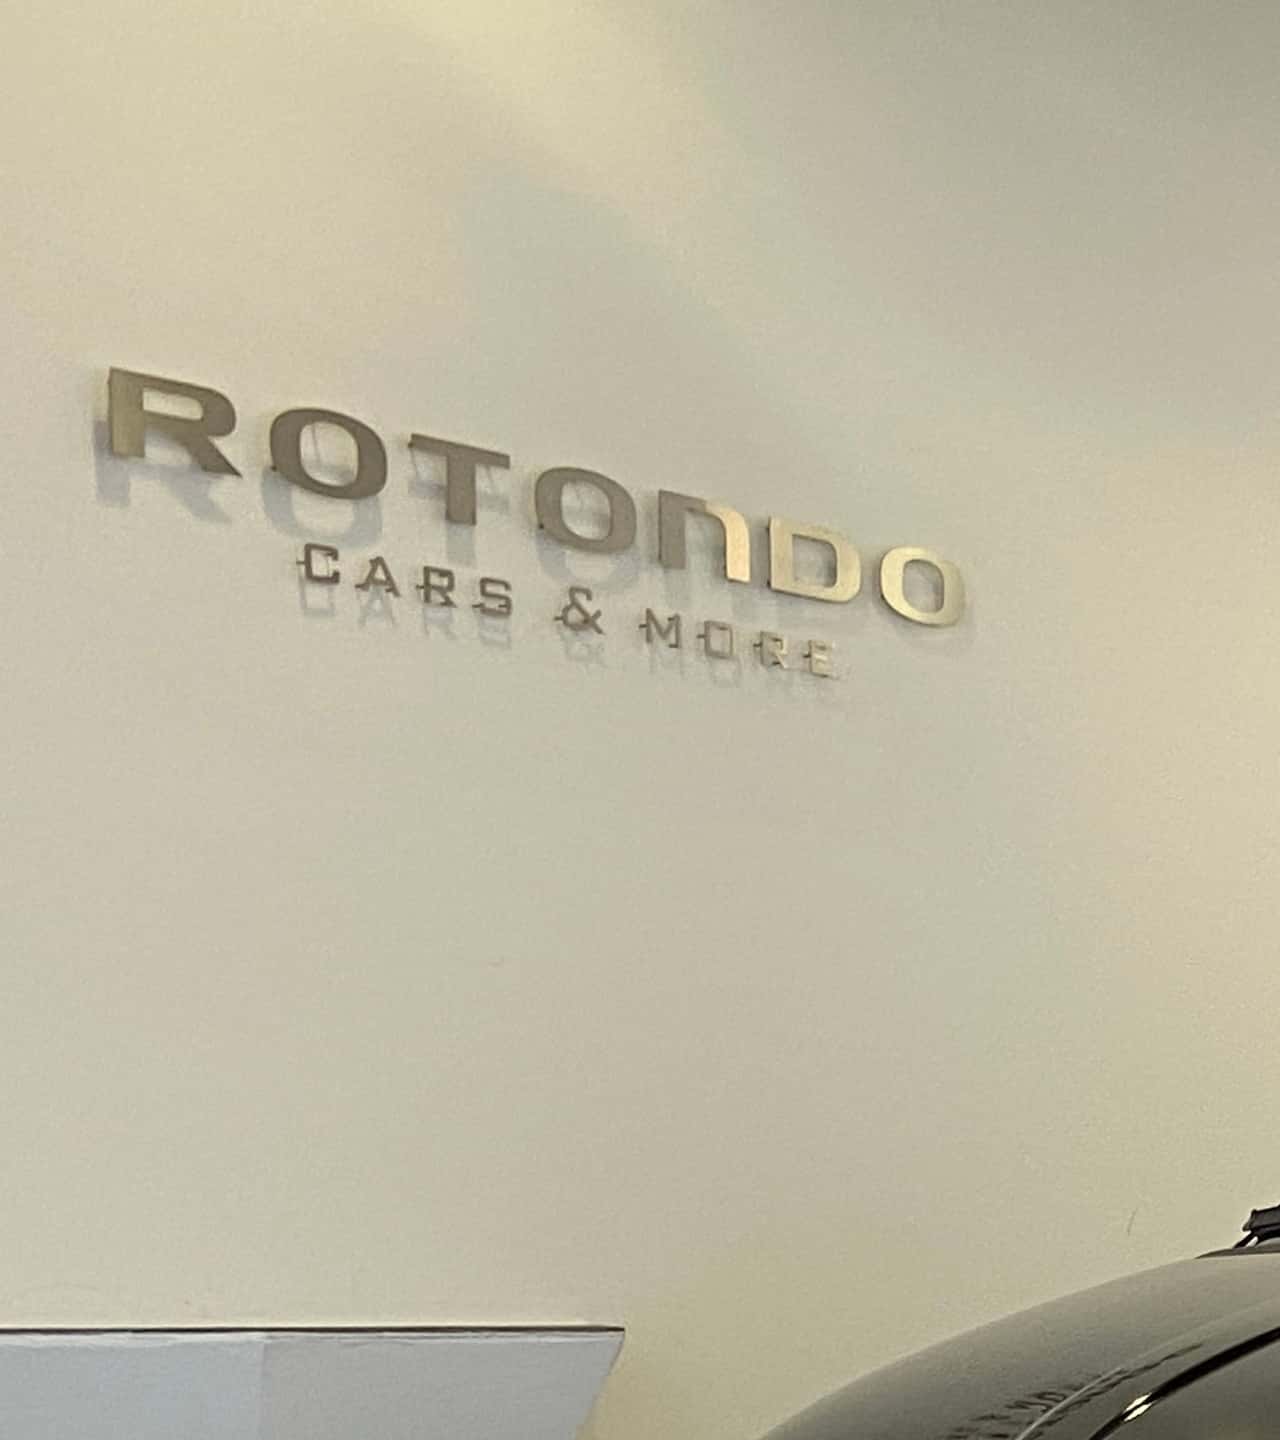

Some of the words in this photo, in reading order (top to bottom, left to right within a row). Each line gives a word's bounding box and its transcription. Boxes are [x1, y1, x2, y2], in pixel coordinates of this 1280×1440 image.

[298, 541, 517, 618] CARS
[554, 586, 605, 634] &
[641, 607, 838, 679] MORE
